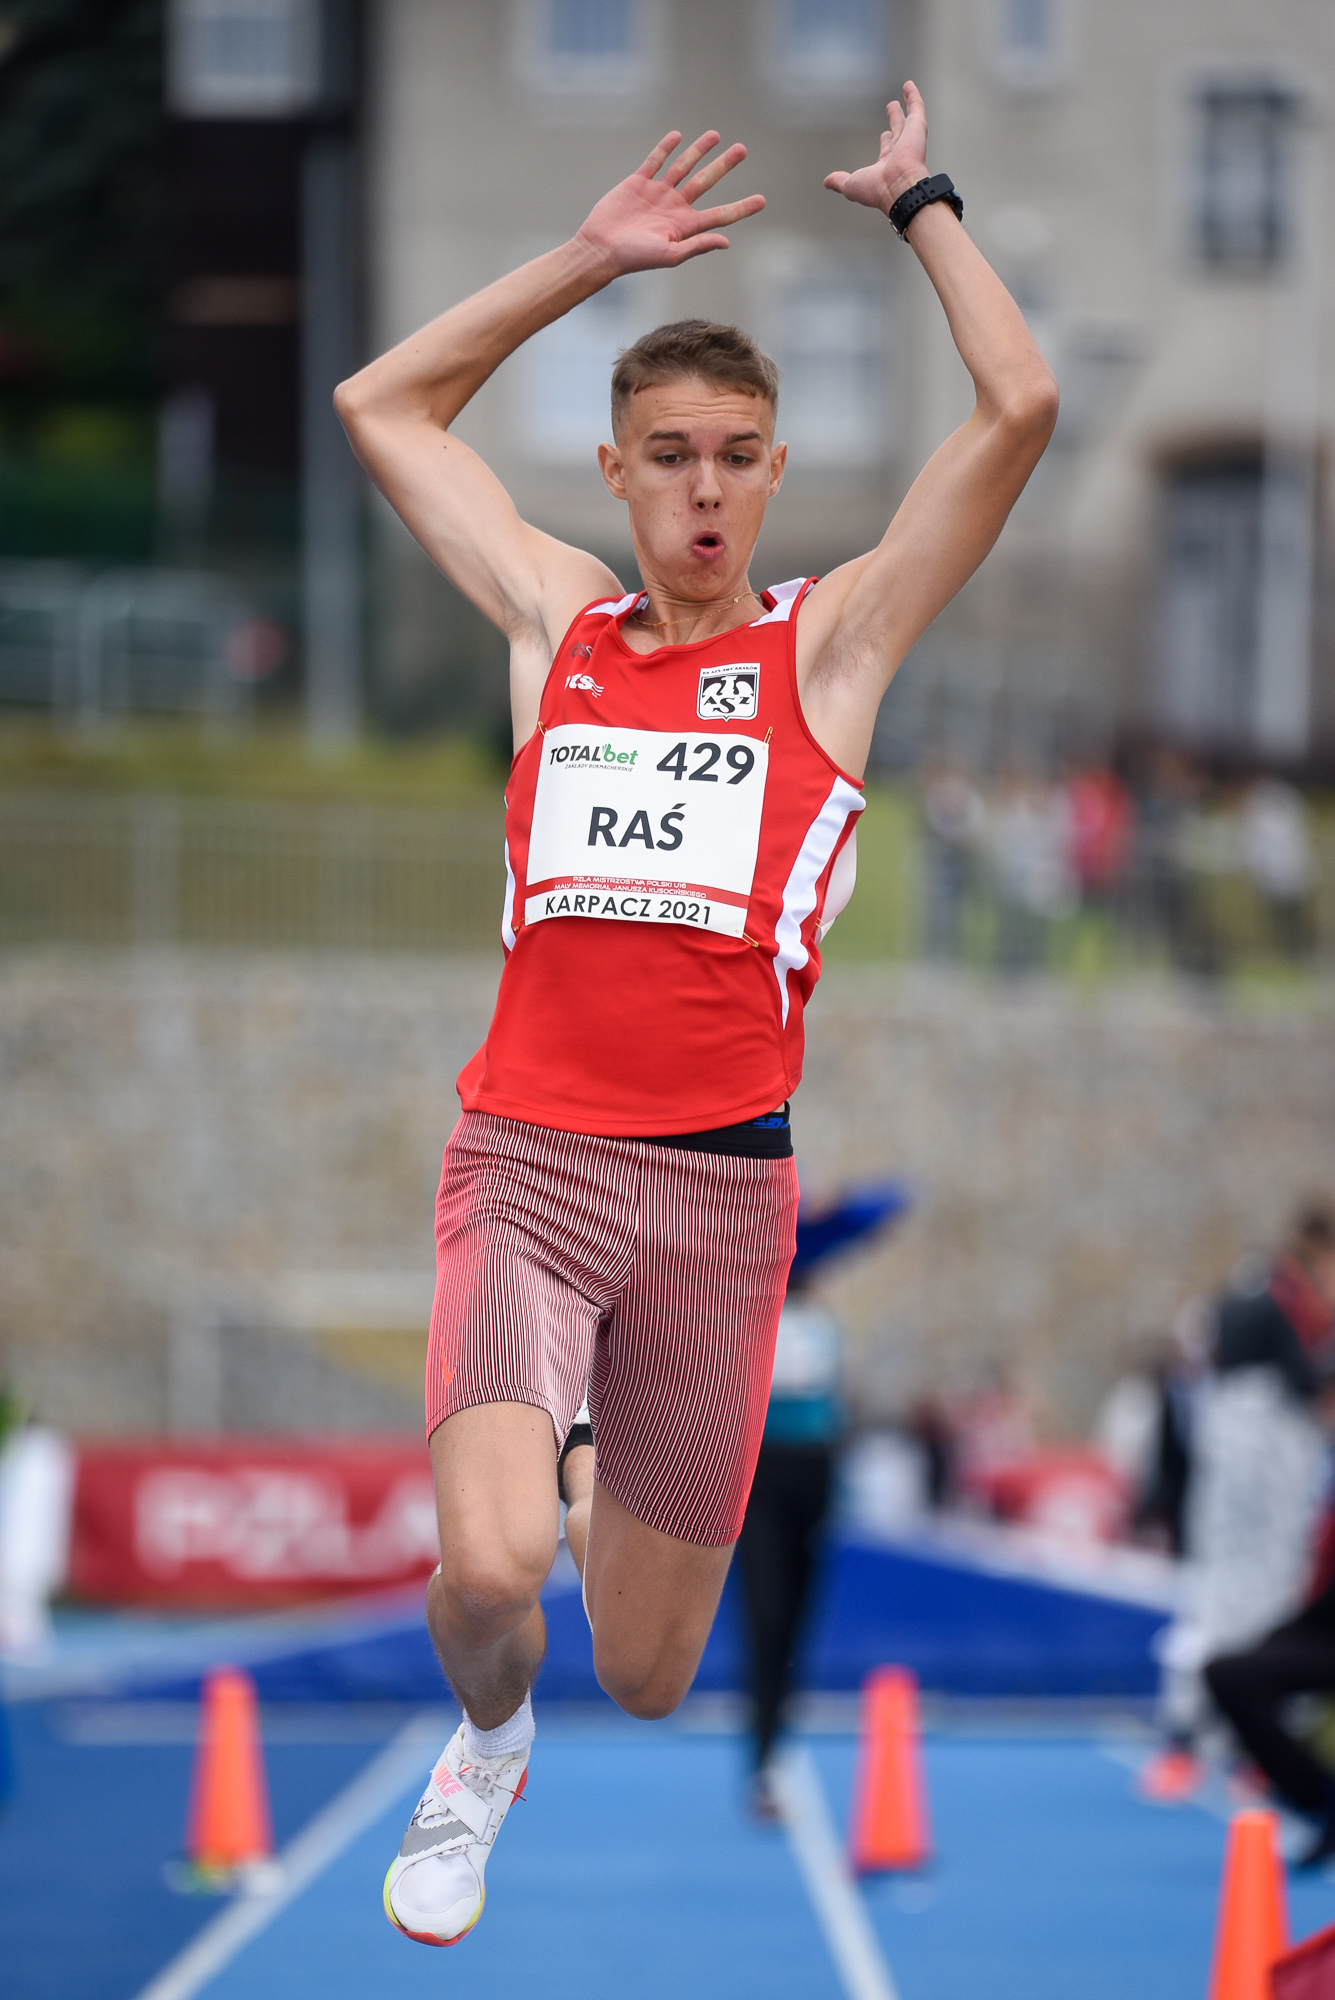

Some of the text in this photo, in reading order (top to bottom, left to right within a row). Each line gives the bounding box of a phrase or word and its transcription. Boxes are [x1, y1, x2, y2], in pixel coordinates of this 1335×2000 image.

[550, 743, 639, 766] TOTALbet
[656, 742, 755, 785] 429
[587, 803, 687, 851] RAŚ
[592, 876, 645, 886] MISTRZOSTWA
[646, 880, 672, 888] POLSKI
[612, 885, 648, 893] JANUSZA
[545, 894, 711, 925] KARPACZ 2021
[433, 1762, 464, 1798] NIKE
